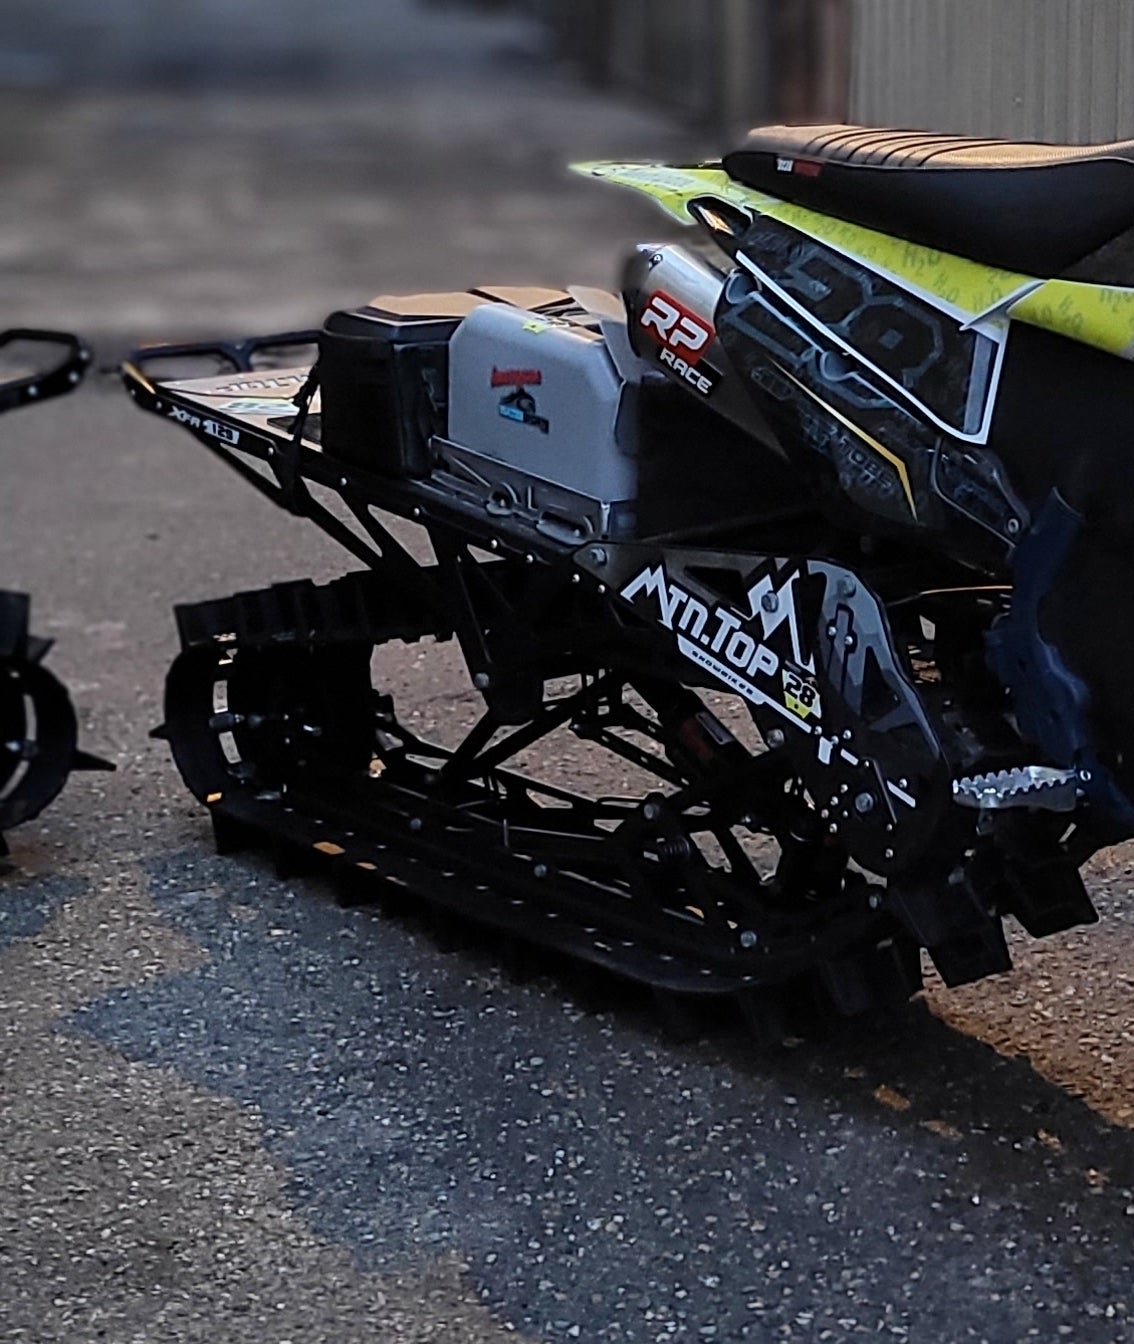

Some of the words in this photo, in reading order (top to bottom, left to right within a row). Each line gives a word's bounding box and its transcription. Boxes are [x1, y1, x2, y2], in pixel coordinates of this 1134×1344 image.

[640, 296, 709, 351] RP
[659, 347, 713, 394] RACE
[785, 672, 816, 708] 28
